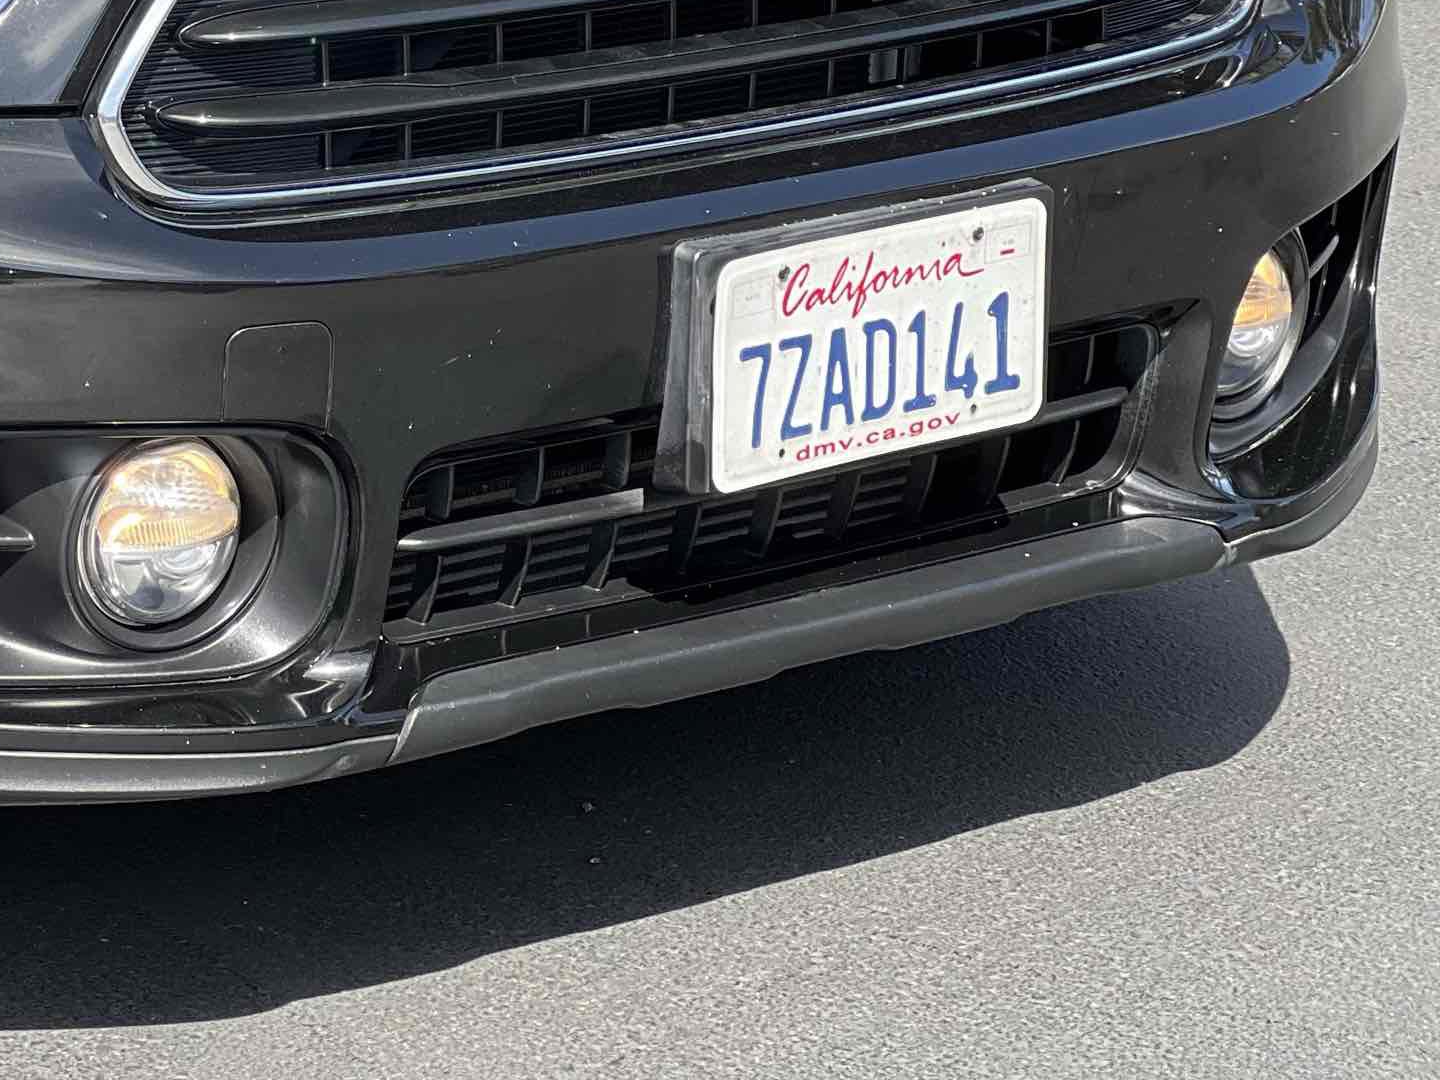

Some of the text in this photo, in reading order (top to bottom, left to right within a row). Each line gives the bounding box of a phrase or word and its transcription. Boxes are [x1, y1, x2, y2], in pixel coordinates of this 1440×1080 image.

[781, 251, 985, 319] California
[739, 291, 1021, 449] 7ZAD141
[795, 411, 961, 462] dmv.ca.gov
